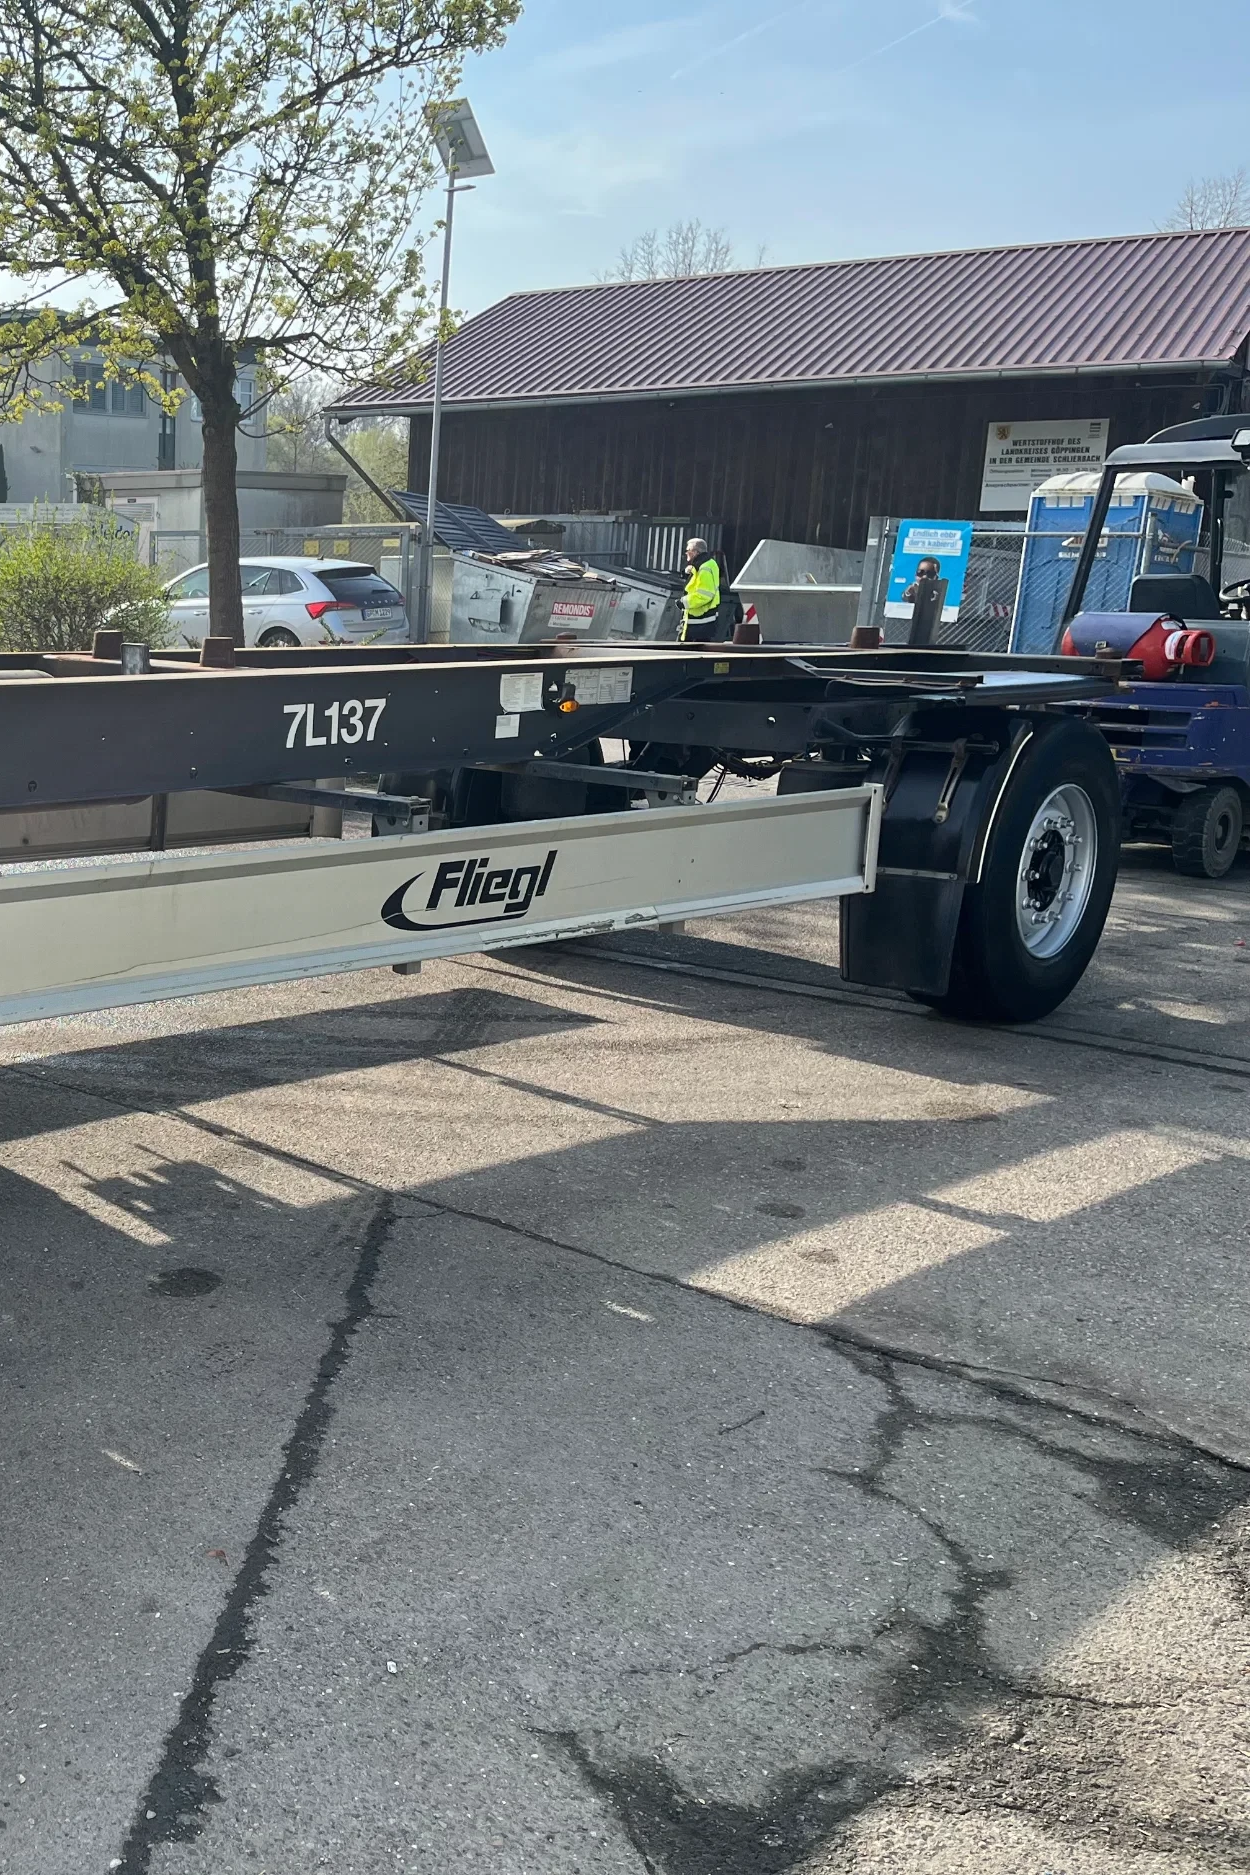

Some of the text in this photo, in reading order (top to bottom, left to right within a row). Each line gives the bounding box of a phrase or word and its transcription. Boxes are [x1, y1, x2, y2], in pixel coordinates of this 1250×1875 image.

[1012, 437, 1082, 447] WERTSTOFFHOF DES
[1001, 446, 1091, 456] LANDKREISES GÖPPINGEN
[989, 454, 1101, 465] IN DER GEMEINDE SCHLIERBACH
[912, 529, 939, 538] Endlich
[553, 602, 592, 616] REMONDIS
[283, 698, 387, 749] 7L137
[425, 849, 558, 914] Fliegl
